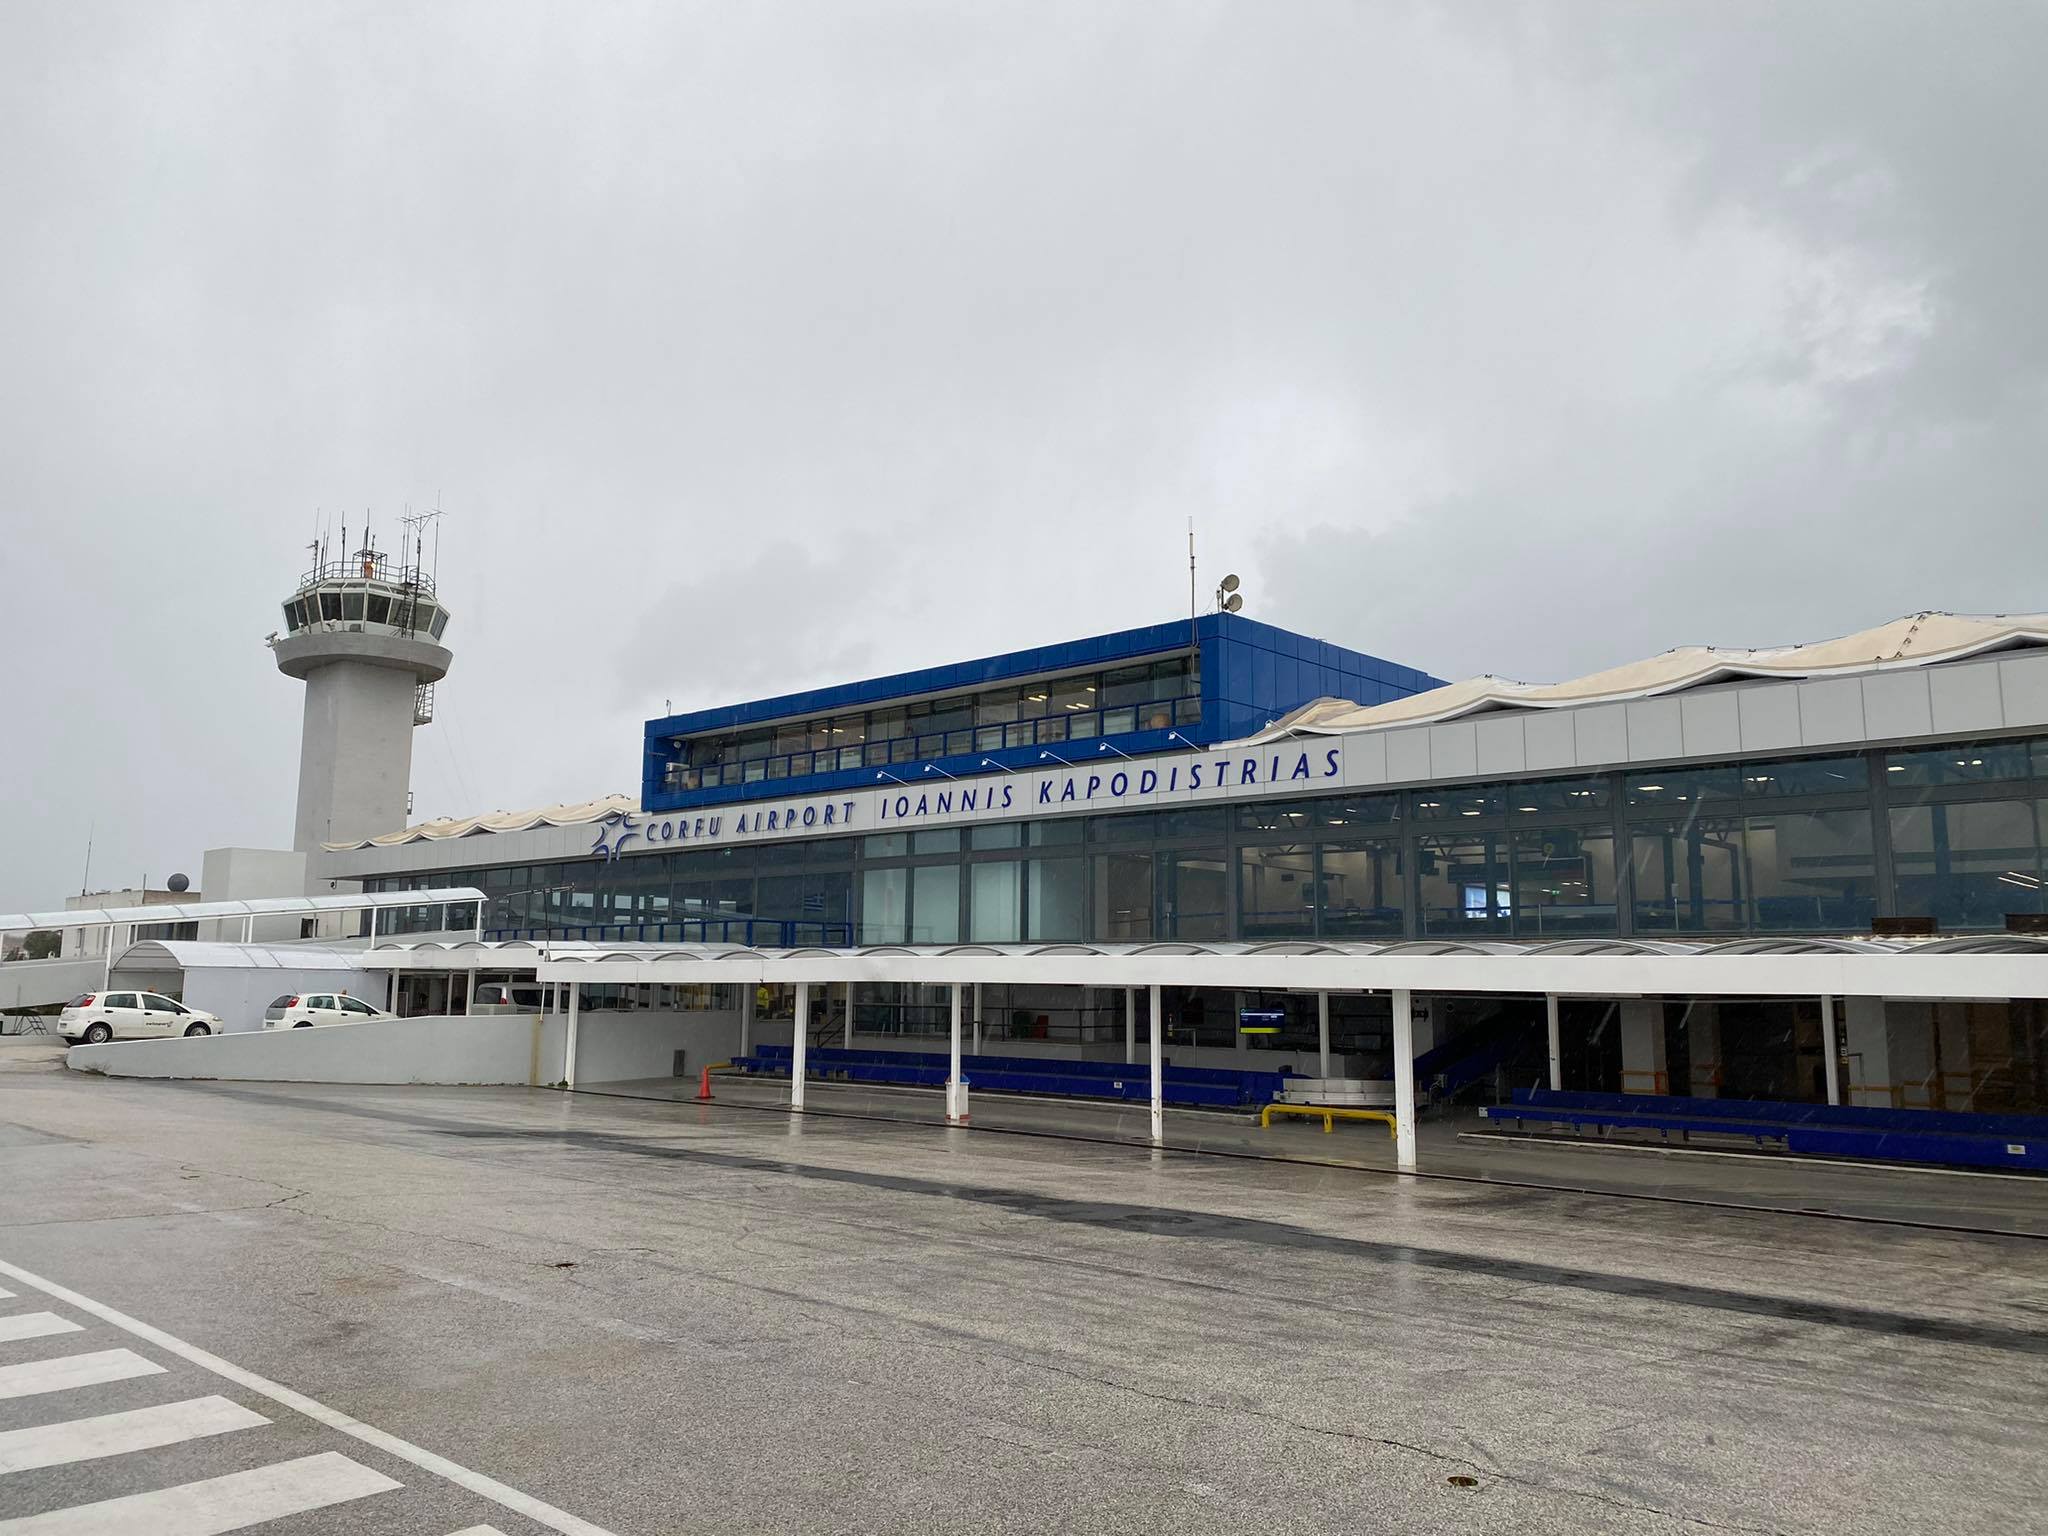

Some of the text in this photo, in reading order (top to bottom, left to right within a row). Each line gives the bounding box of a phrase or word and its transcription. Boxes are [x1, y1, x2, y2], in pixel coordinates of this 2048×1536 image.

[646, 750, 1339, 841] CORFU AIRPORT IOANNIS KAPODISTRIAS
